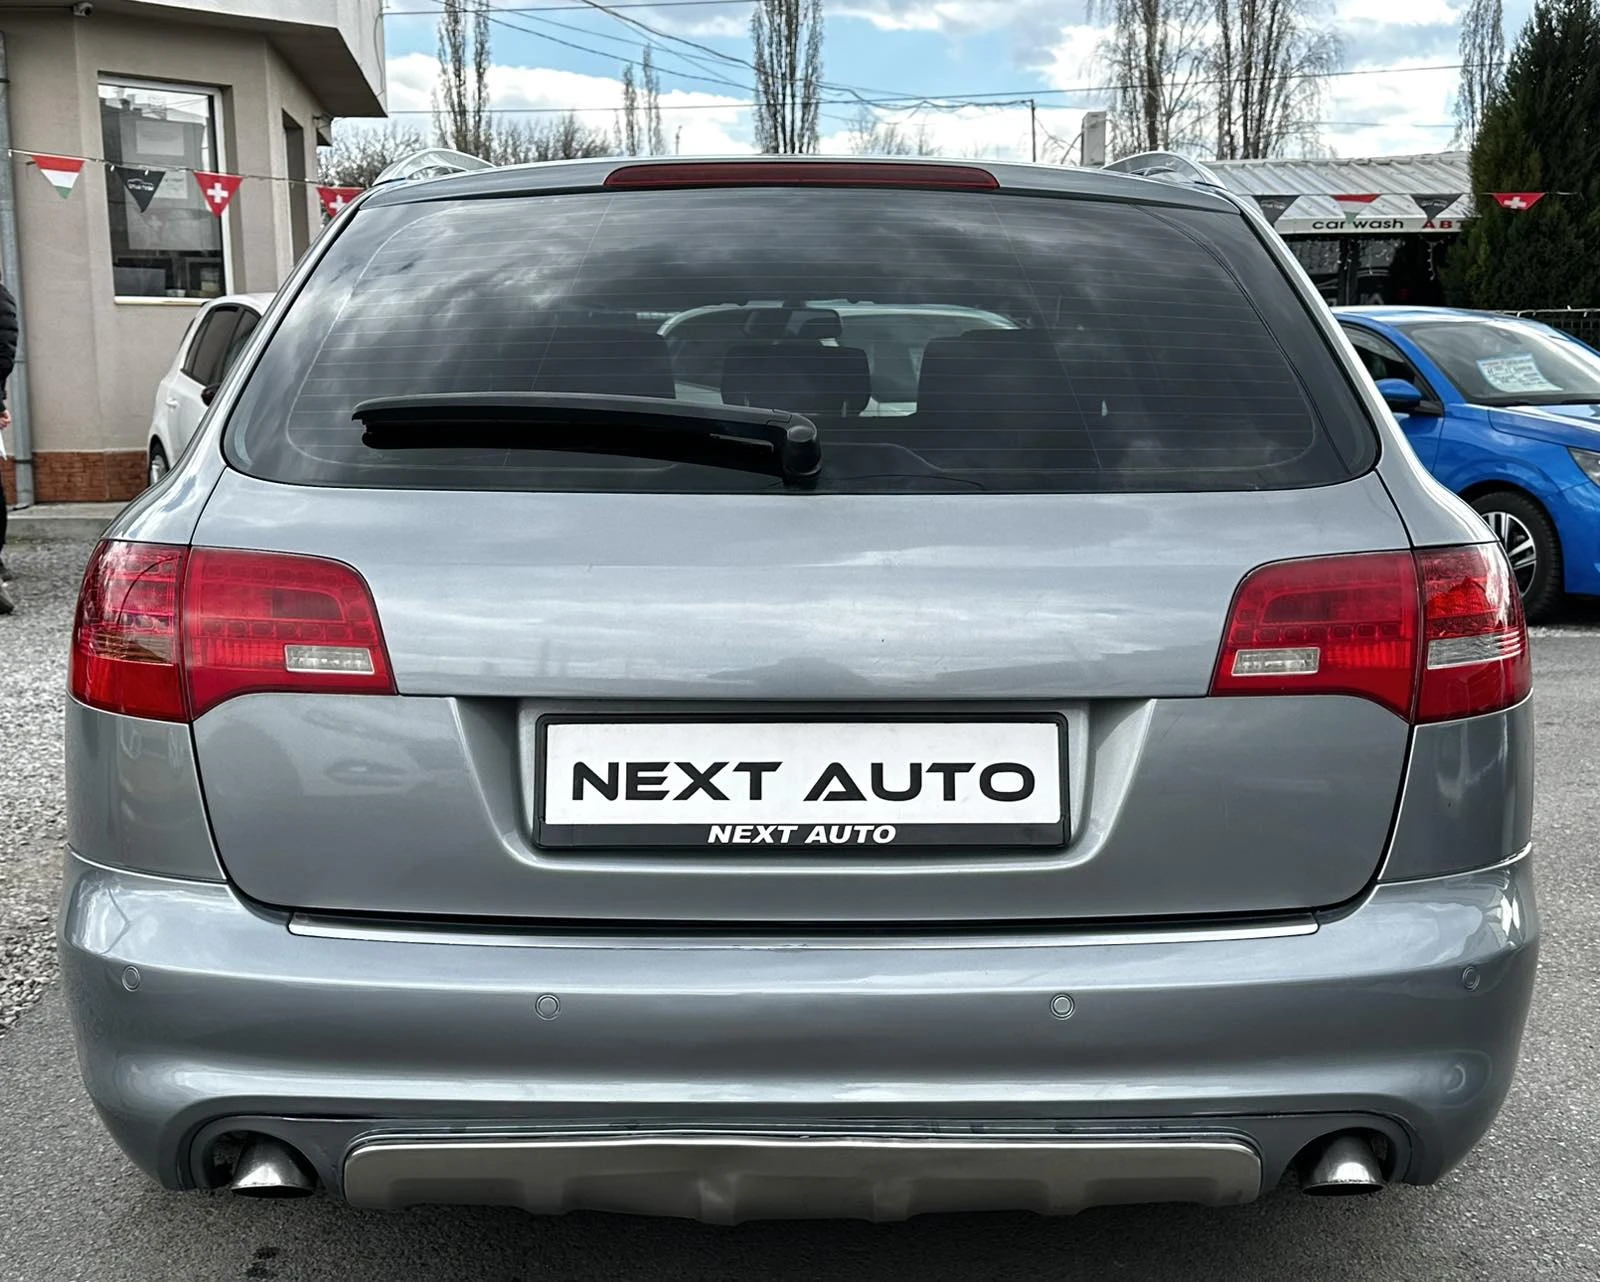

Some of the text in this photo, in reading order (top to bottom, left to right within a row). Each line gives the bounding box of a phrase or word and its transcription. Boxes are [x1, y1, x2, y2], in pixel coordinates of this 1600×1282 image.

[1312, 218, 1404, 230] car wash
[572, 761, 1036, 802] NEXT AUTO
[707, 825, 897, 844] NEXT AUTO
